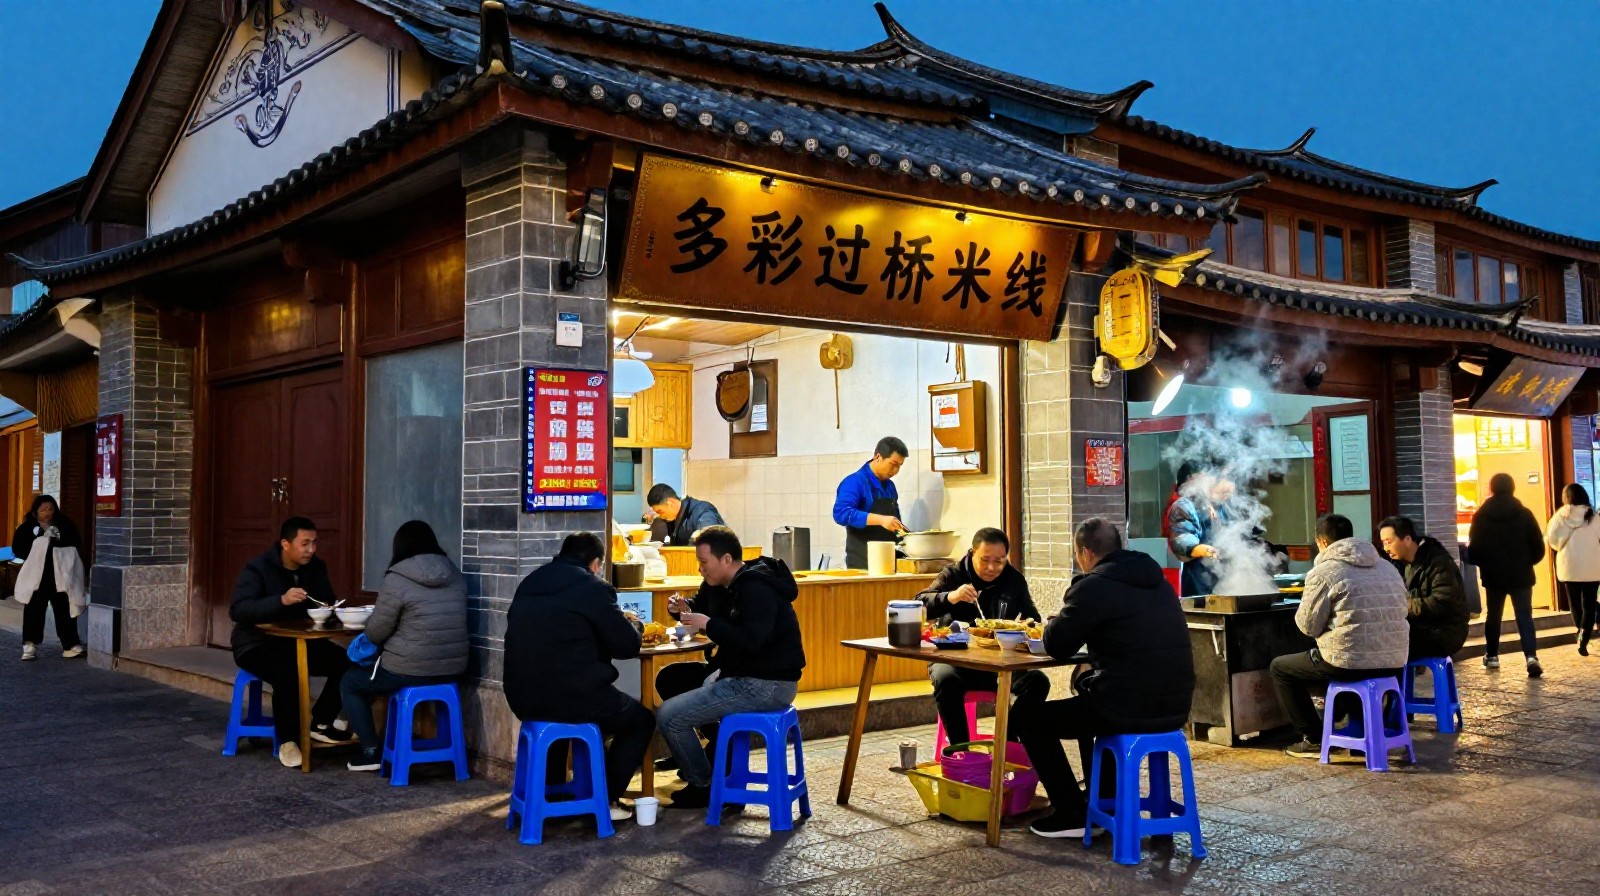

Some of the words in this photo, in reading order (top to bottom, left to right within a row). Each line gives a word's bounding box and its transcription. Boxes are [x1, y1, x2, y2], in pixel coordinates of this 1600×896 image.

[670, 197, 1047, 318] 多彩过桥米线
